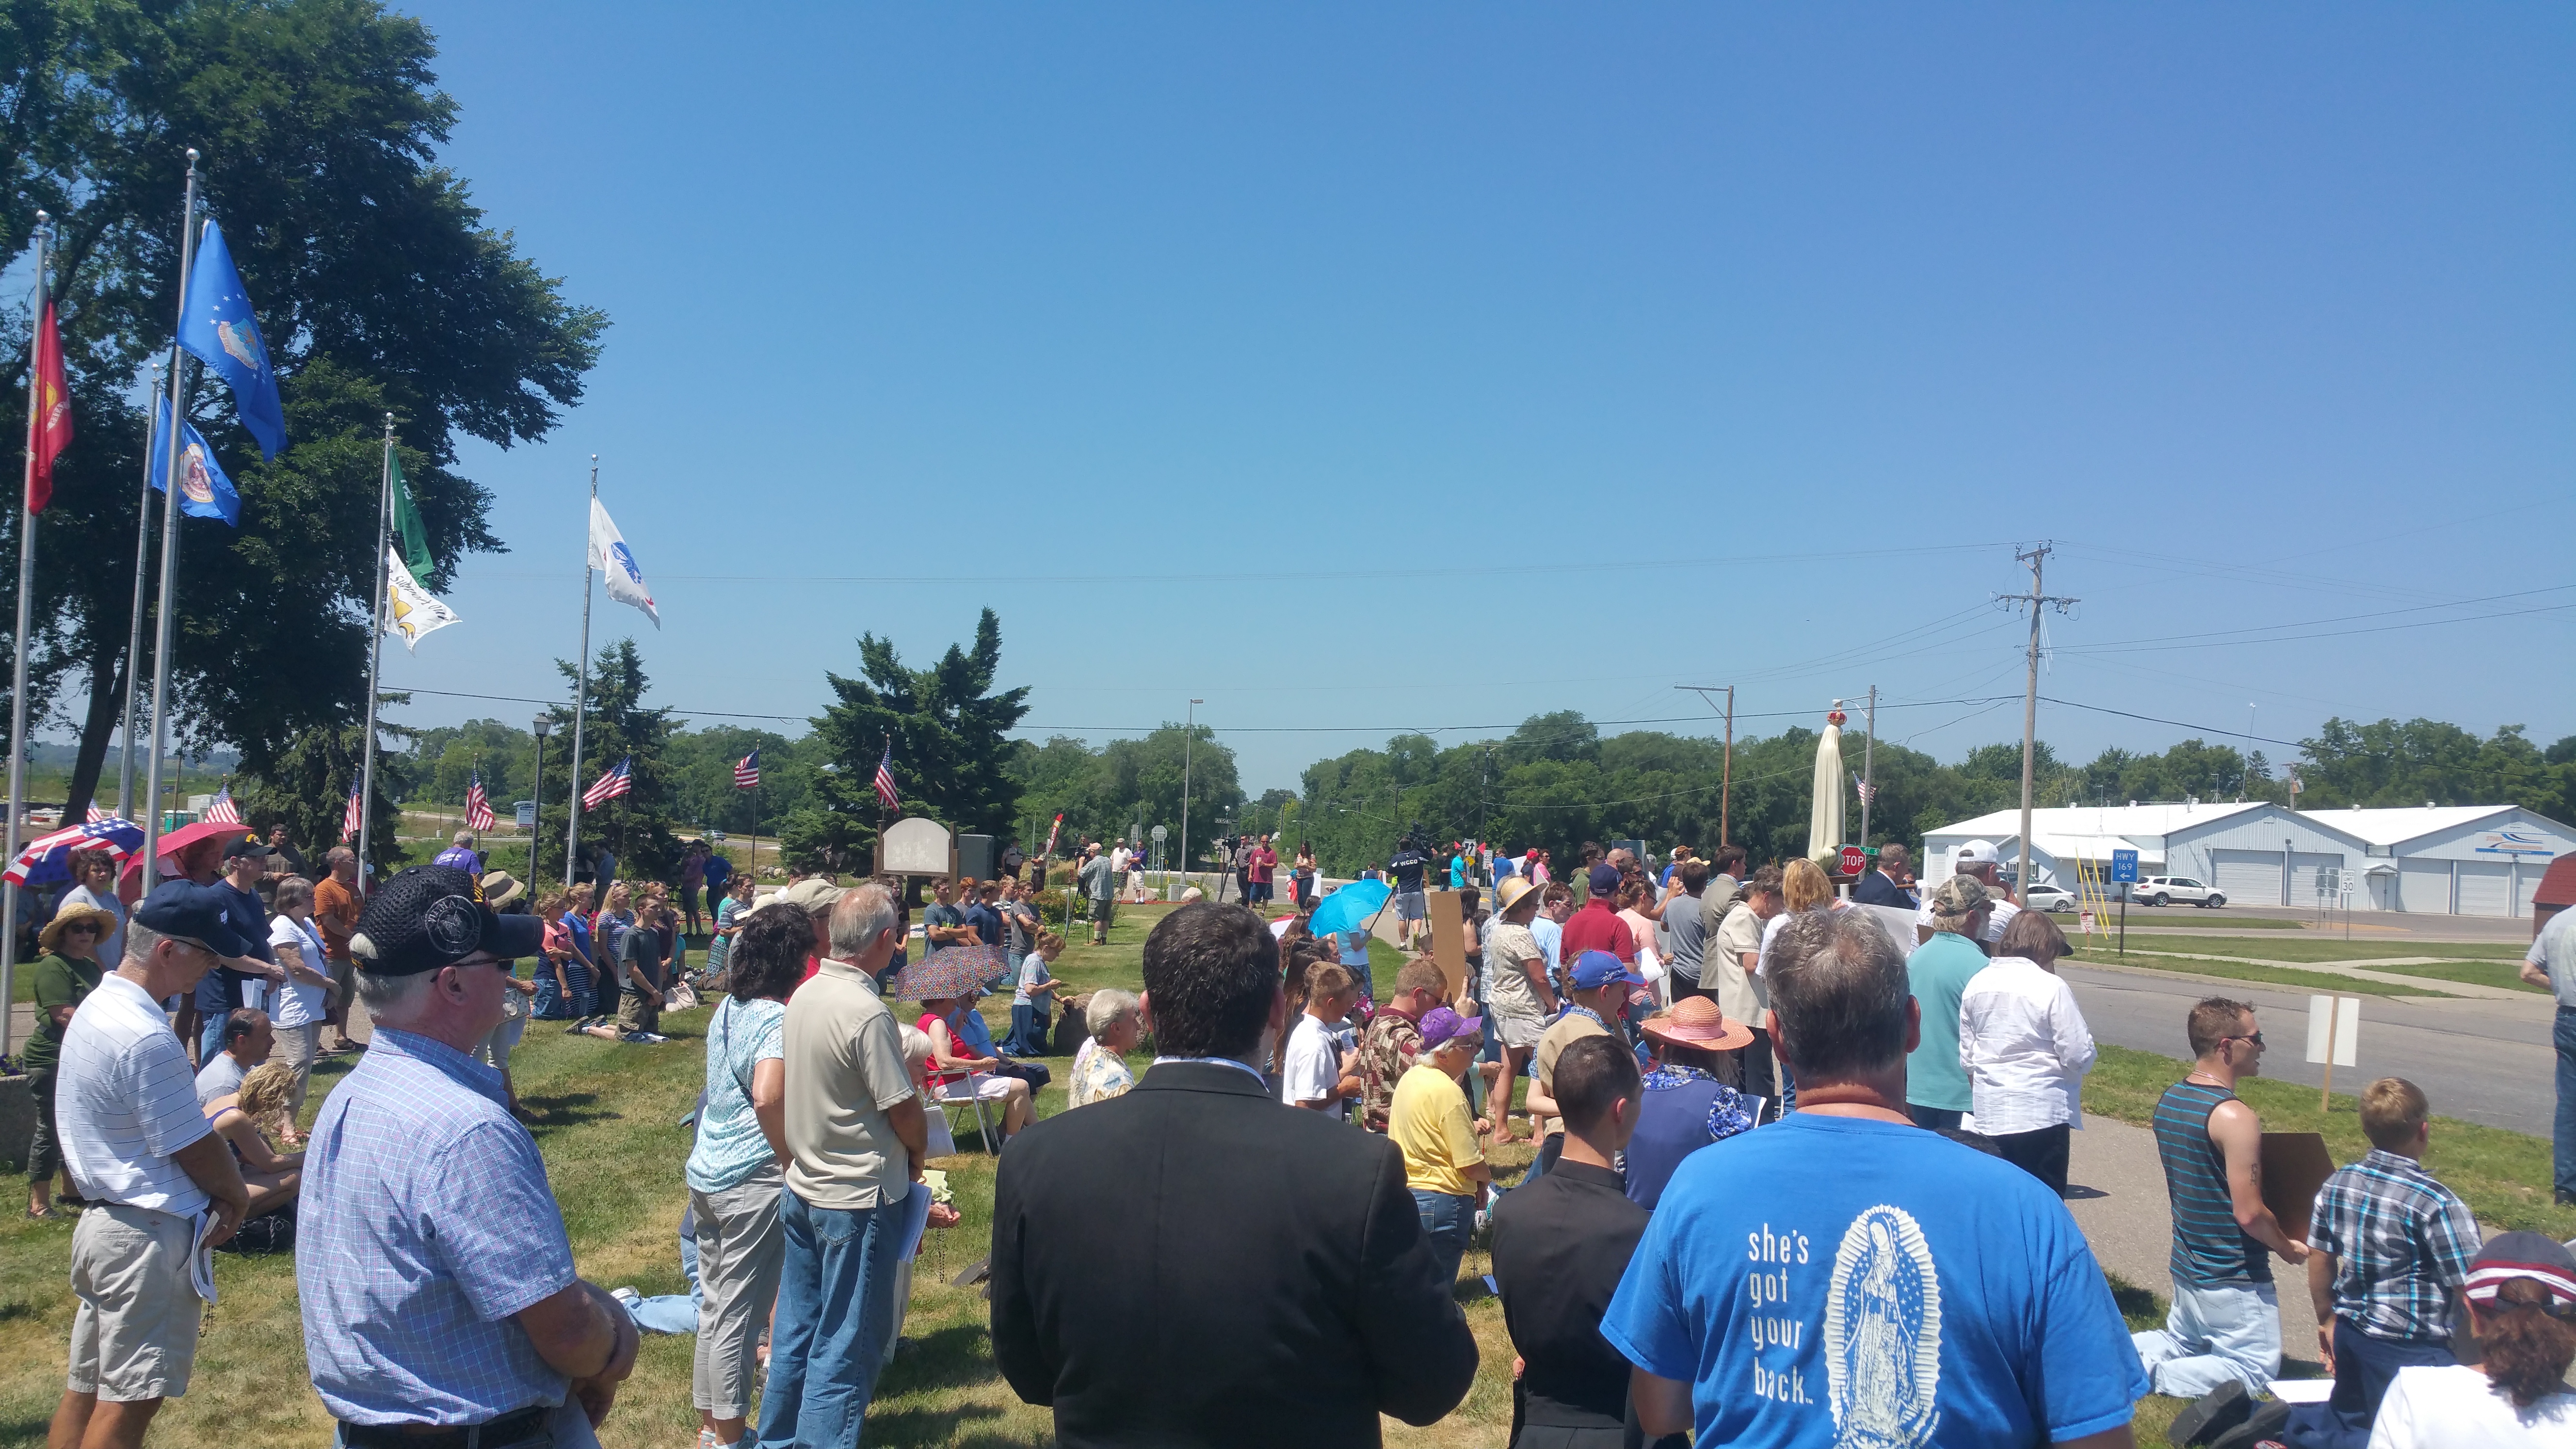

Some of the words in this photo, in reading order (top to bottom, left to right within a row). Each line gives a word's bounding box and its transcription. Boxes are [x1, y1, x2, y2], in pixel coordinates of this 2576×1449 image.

[184, 483, 205, 498] MINNESOTA
[390, 576, 432, 605] Support
[2116, 853, 2135, 861] HWY
[2343, 882, 2353, 891] 30
[1748, 1223, 1809, 1265] she's
[1749, 1267, 1789, 1308] got
[1751, 1316, 1804, 1351] your
